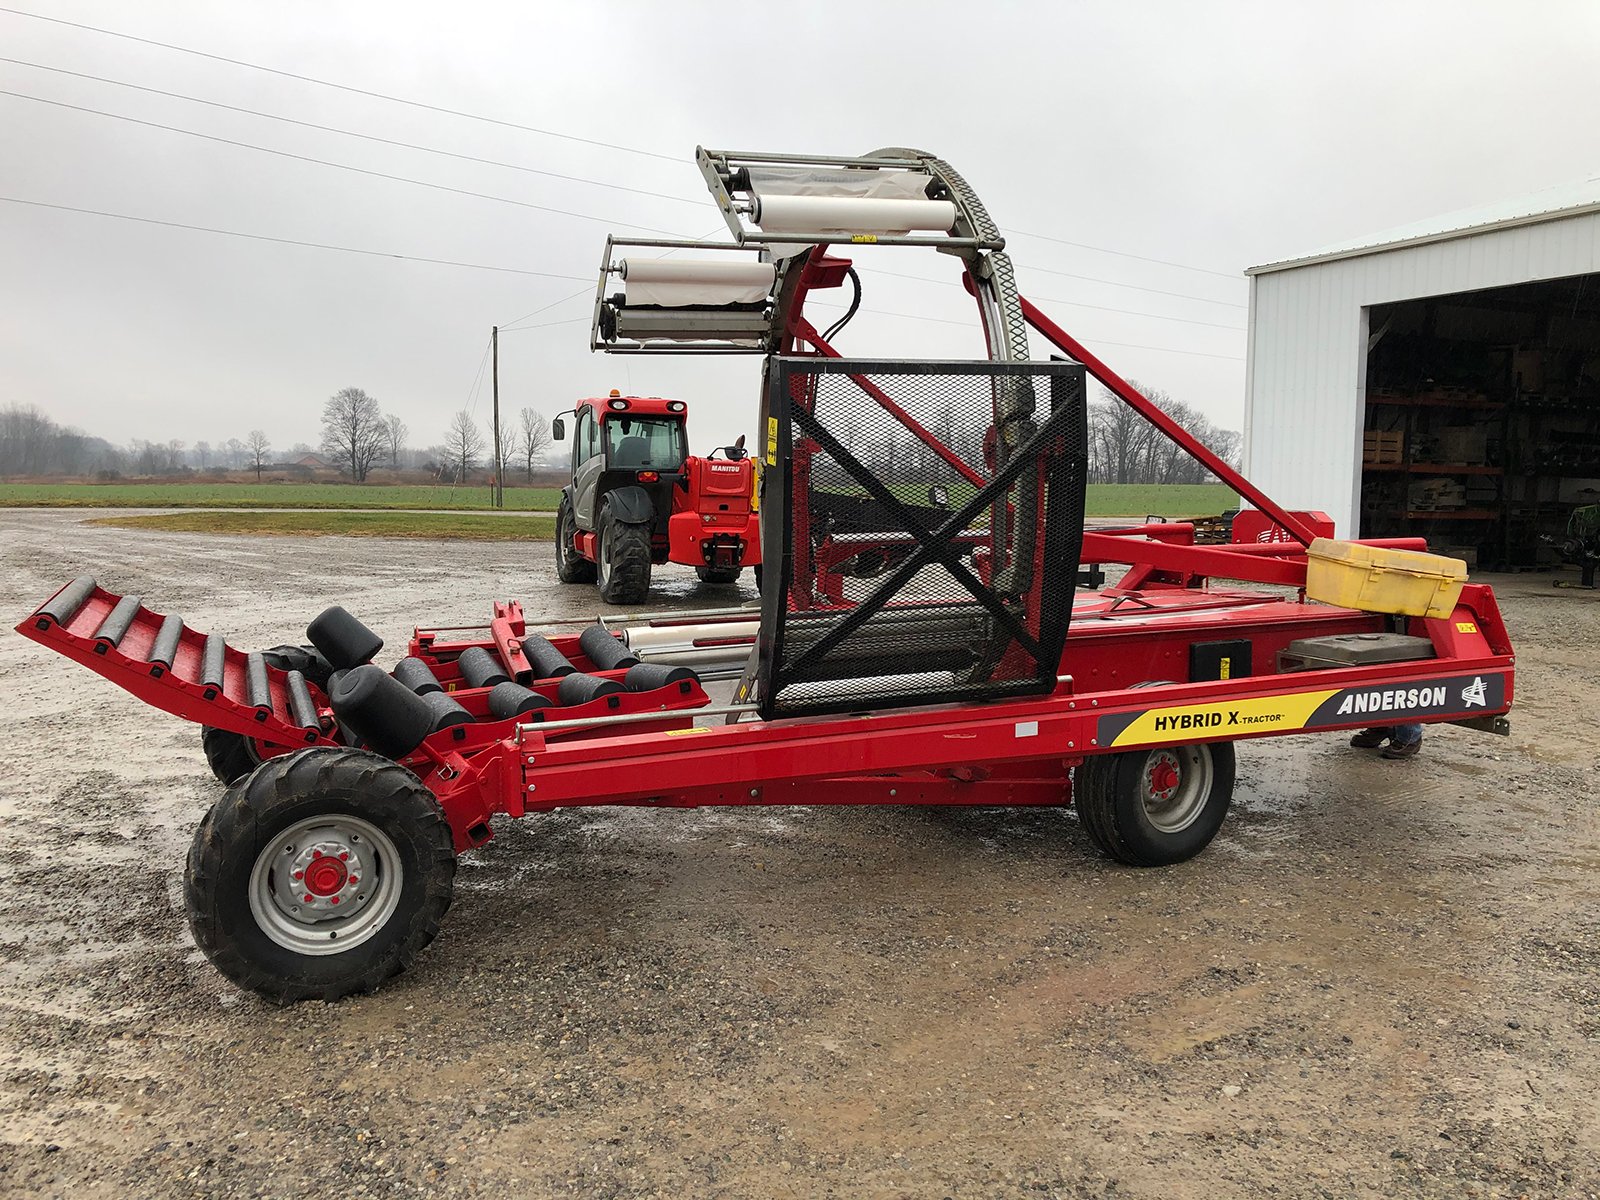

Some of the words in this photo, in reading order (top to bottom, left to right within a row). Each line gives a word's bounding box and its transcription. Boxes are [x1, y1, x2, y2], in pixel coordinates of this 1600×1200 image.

[711, 465, 740, 473] MANITOU
[1336, 686, 1447, 715] ANDERSON
[1154, 712, 1222, 731] HYBRID
